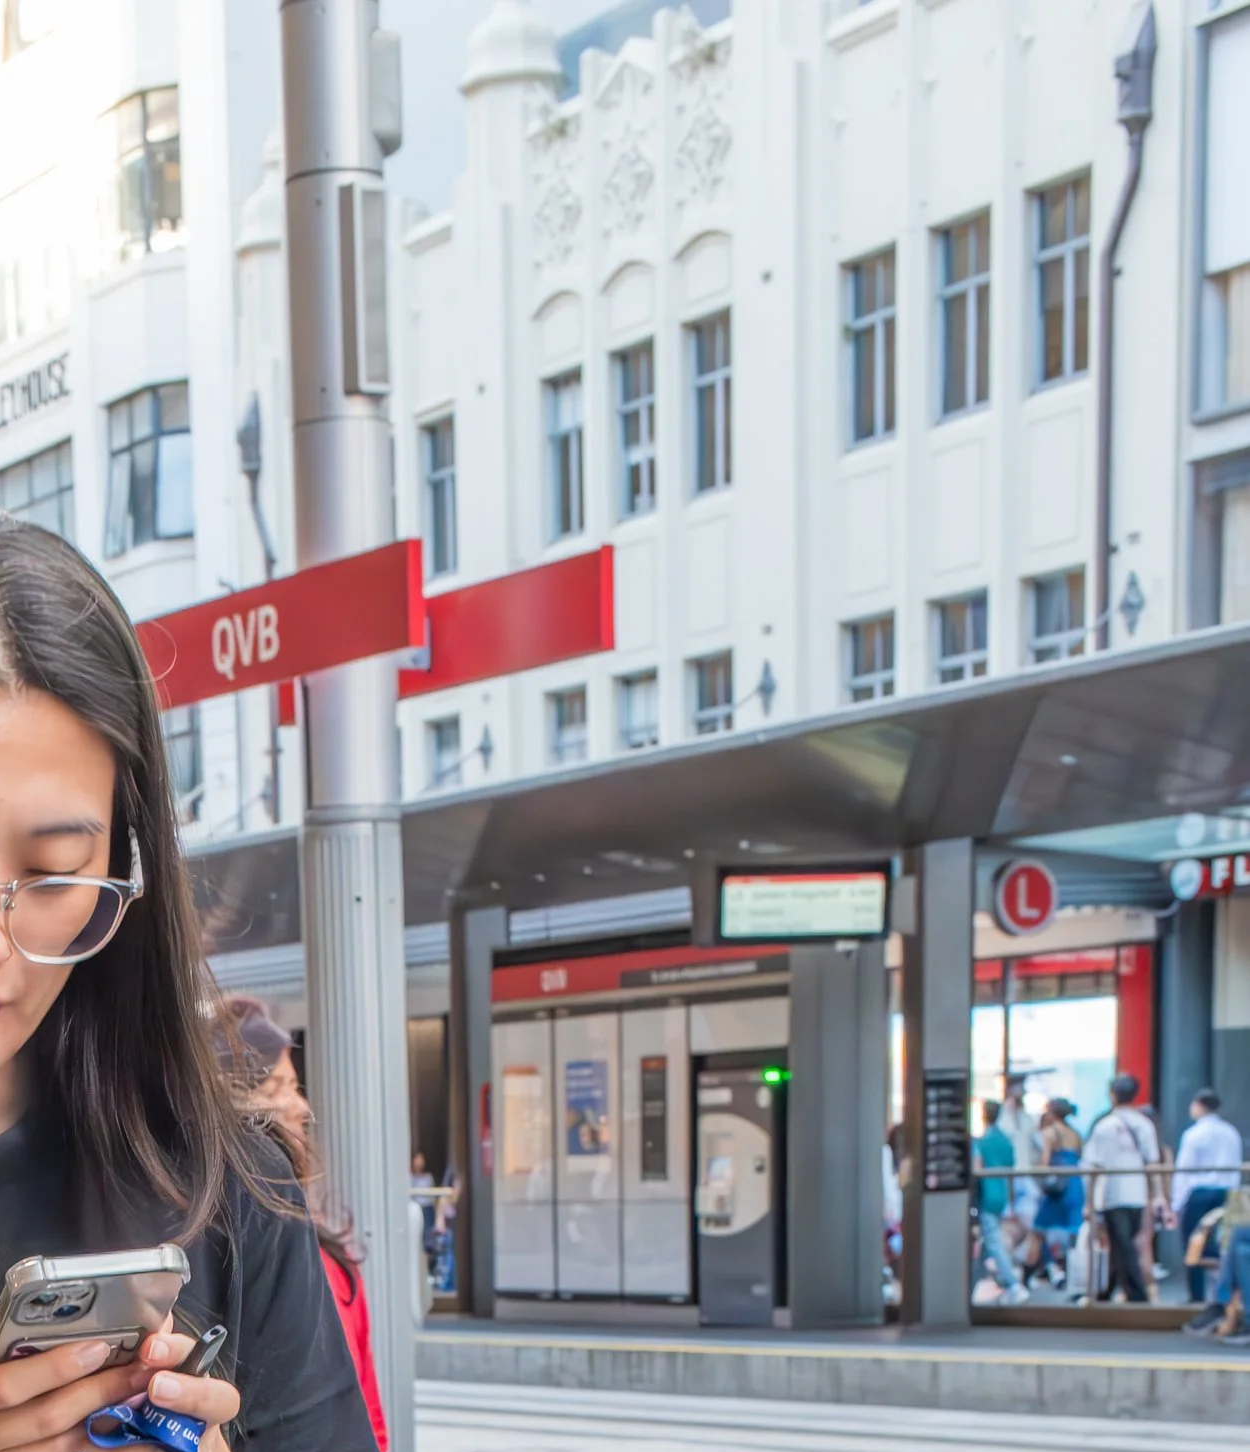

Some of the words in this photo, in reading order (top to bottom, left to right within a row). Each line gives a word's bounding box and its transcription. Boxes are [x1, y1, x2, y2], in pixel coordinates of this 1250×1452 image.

[212, 604, 280, 680] QVB
[1017, 873, 1040, 919] L
[166, 1419, 181, 1436] in
